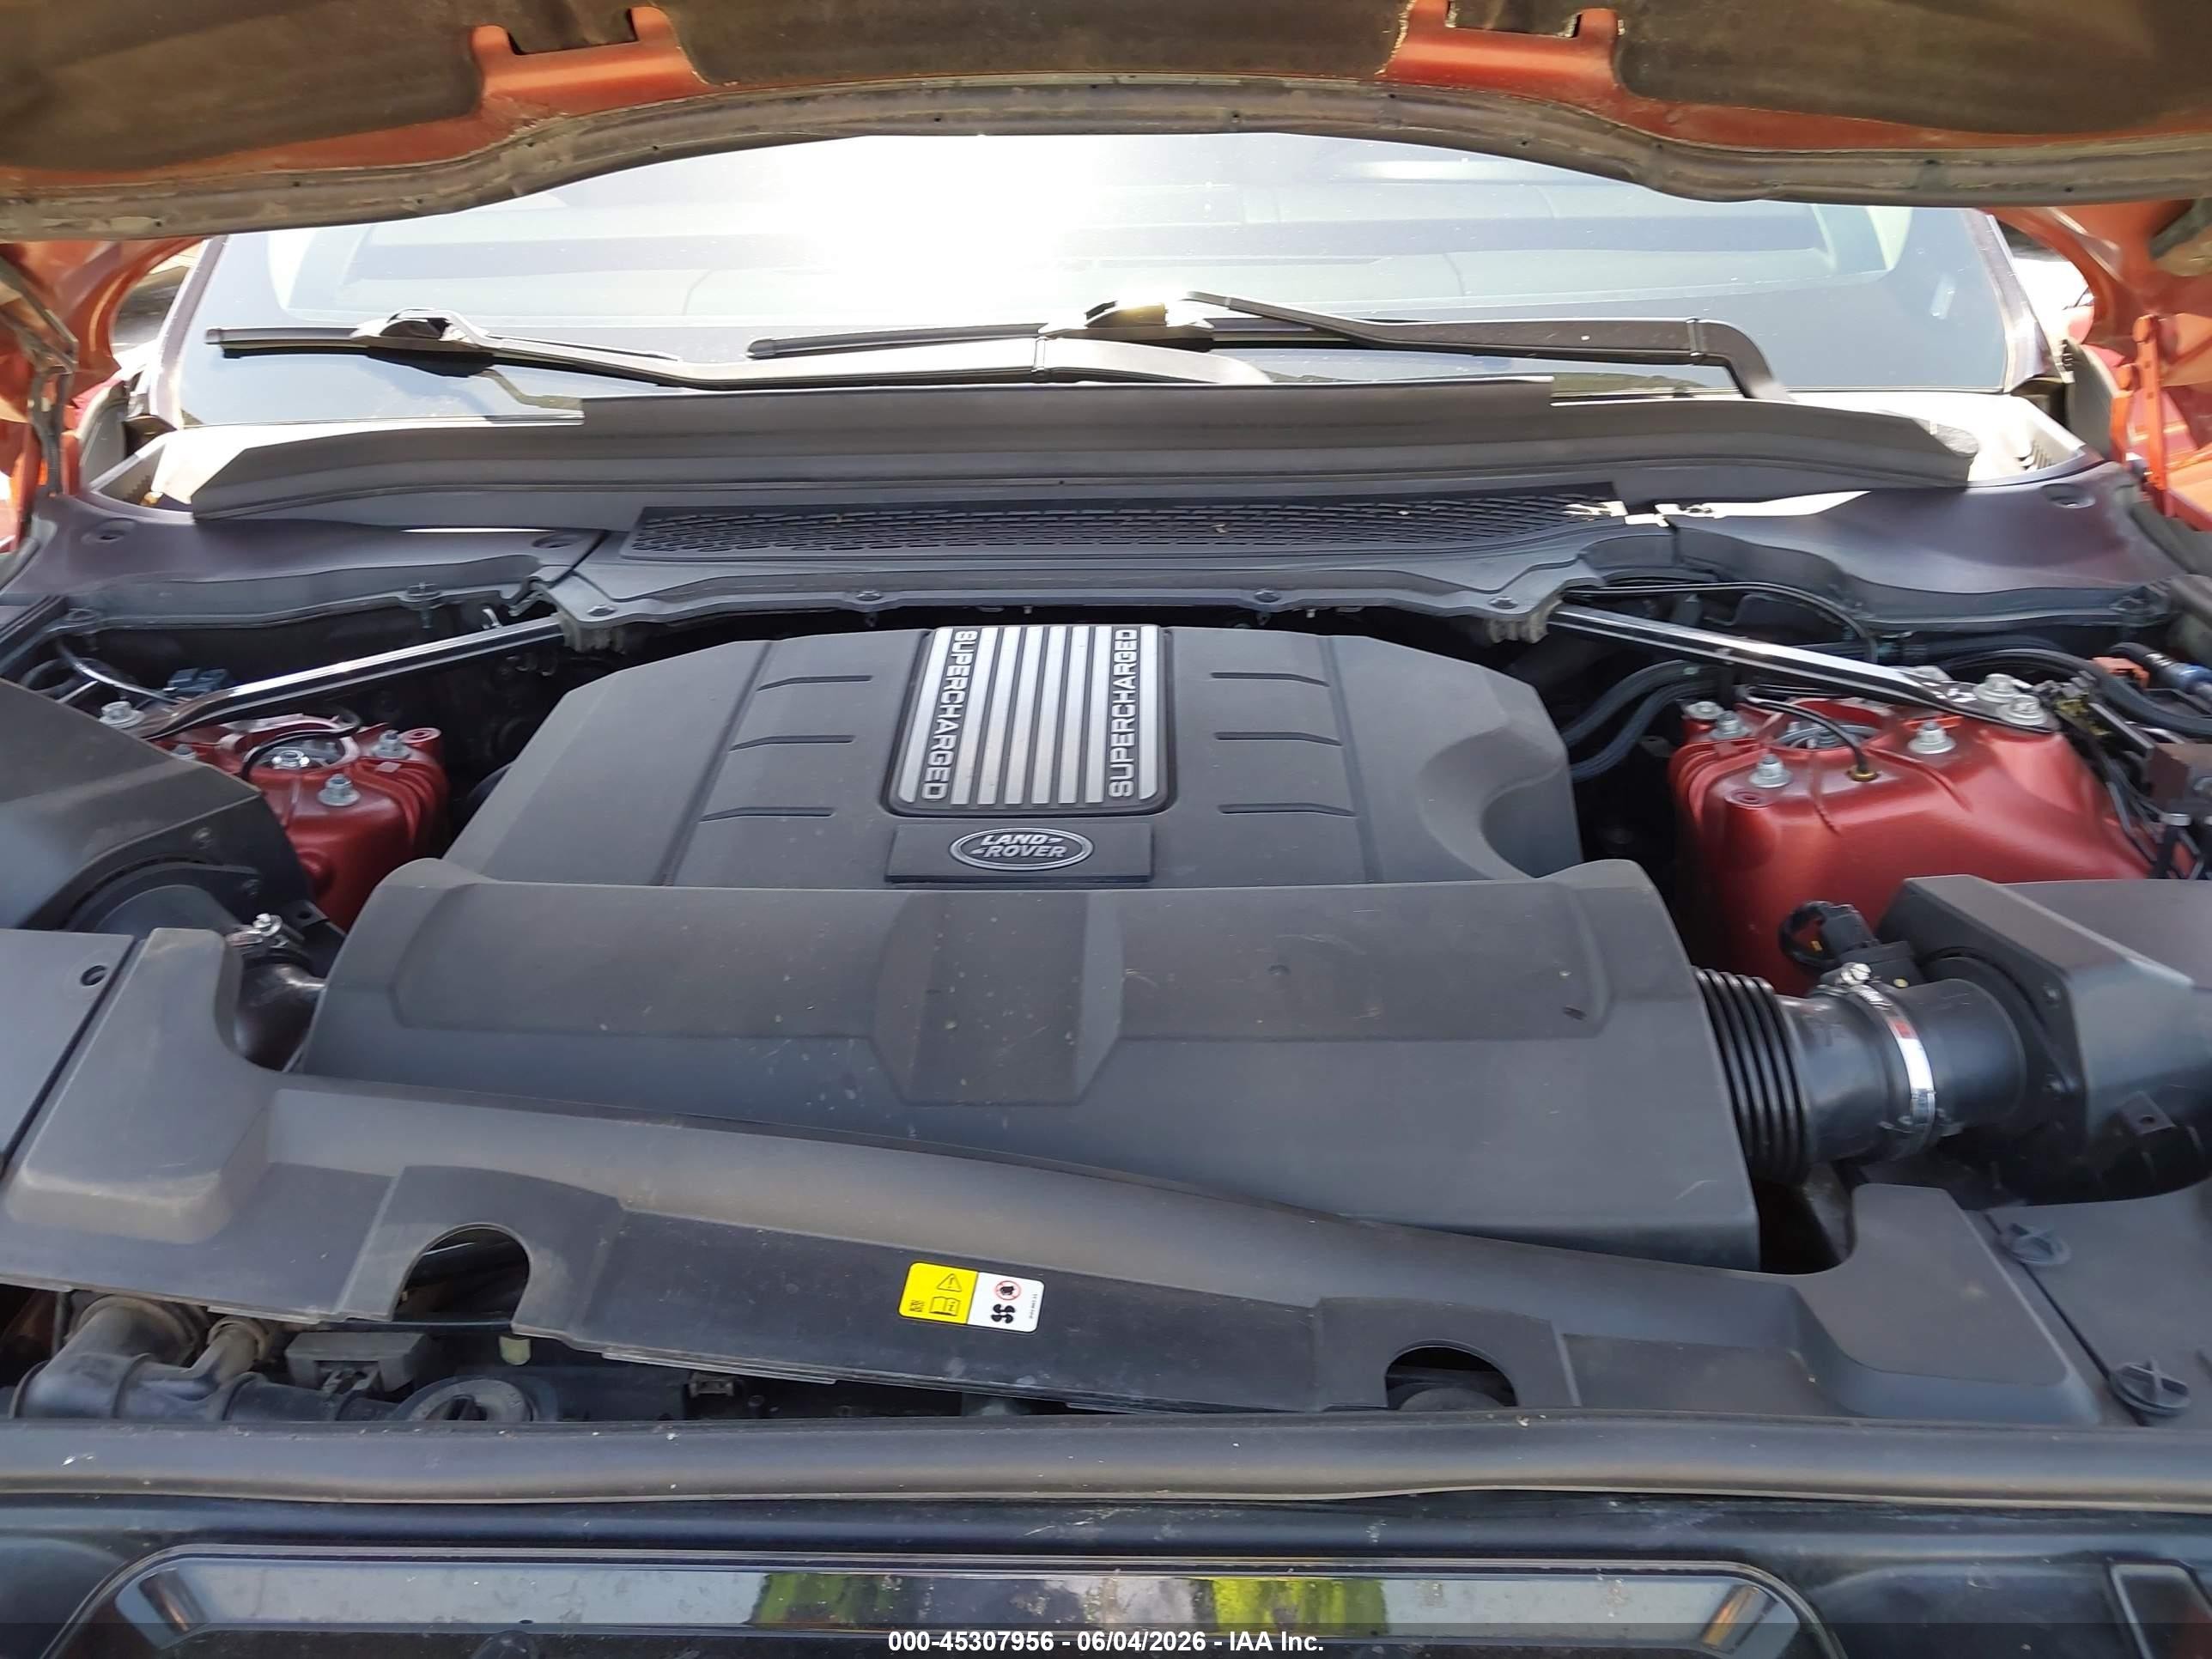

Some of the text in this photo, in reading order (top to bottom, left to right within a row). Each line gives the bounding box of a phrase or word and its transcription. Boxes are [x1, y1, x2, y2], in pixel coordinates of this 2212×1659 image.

[921, 629, 978, 800] SUPERCHARGED
[1108, 629, 1138, 798] SUPERCHARGED
[981, 834, 1048, 846] LAND
[982, 845, 1067, 858] ROVER
